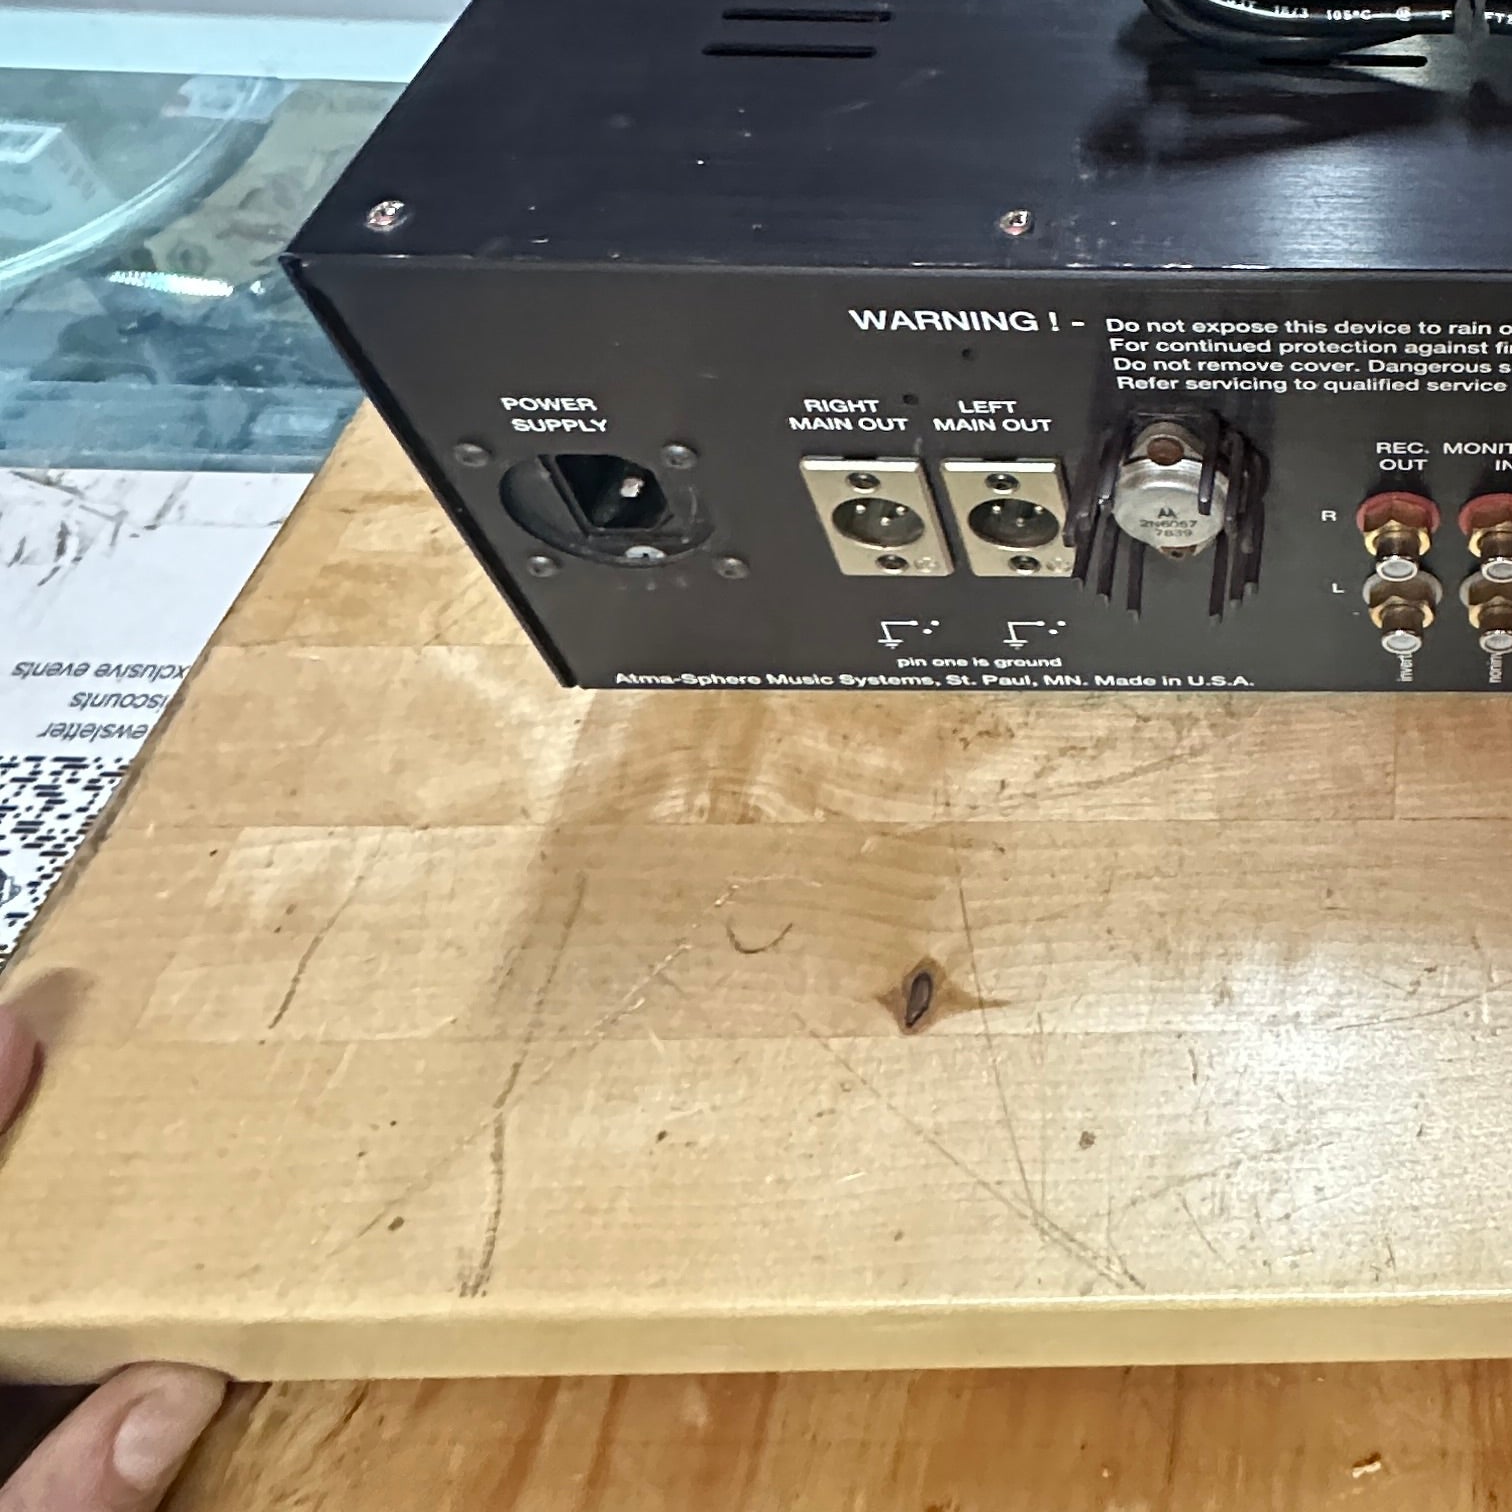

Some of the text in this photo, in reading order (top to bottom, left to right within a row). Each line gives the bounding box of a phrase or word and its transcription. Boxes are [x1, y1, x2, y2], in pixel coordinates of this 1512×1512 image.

[847, 309, 1040, 332] WARNING
[1048, 311, 1061, 332] !
[1105, 318, 1141, 333] Do
[1146, 319, 1186, 333] not
[1191, 322, 1279, 339] expose
[1284, 320, 1328, 335] this
[1333, 320, 1412, 335] device
[1417, 321, 1442, 335] to
[1448, 321, 1492, 336] rain
[1108, 337, 1150, 352] For
[1155, 338, 1272, 353] continued
[1278, 339, 1398, 356] protection
[1403, 340, 1489, 357] against
[1112, 356, 1147, 372] Do
[1152, 358, 1193, 372] not
[1197, 360, 1285, 372] remove
[1289, 361, 1361, 373] cover.
[1367, 359, 1493, 376] Dangerous
[1116, 375, 1180, 390] Refer
[1185, 376, 1288, 394] servicing
[1293, 378, 1320, 391] to
[1323, 377, 1420, 394] qualified
[1426, 378, 1508, 392] service
[499, 396, 598, 412] POWER
[803, 398, 880, 414] RIGHT
[957, 399, 1018, 414] LEFT
[510, 418, 608, 433] SUPPLY
[788, 416, 909, 432] MAIN OUT
[932, 417, 1053, 433] MAIN OUT
[1376, 441, 1431, 456] REC.
[1378, 457, 1429, 471] OUT
[1321, 509, 1337, 522] R
[1331, 582, 1345, 594] L
[896, 656, 1063, 670] pin one is ground
[11, 661, 191, 683] xclusive events
[615, 672, 1255, 687] Atma-Sphere Music Systems, St. Paul, MN. Made in U.S.A.
[69, 691, 170, 714] iscounts
[36, 721, 149, 743] ewsletter
